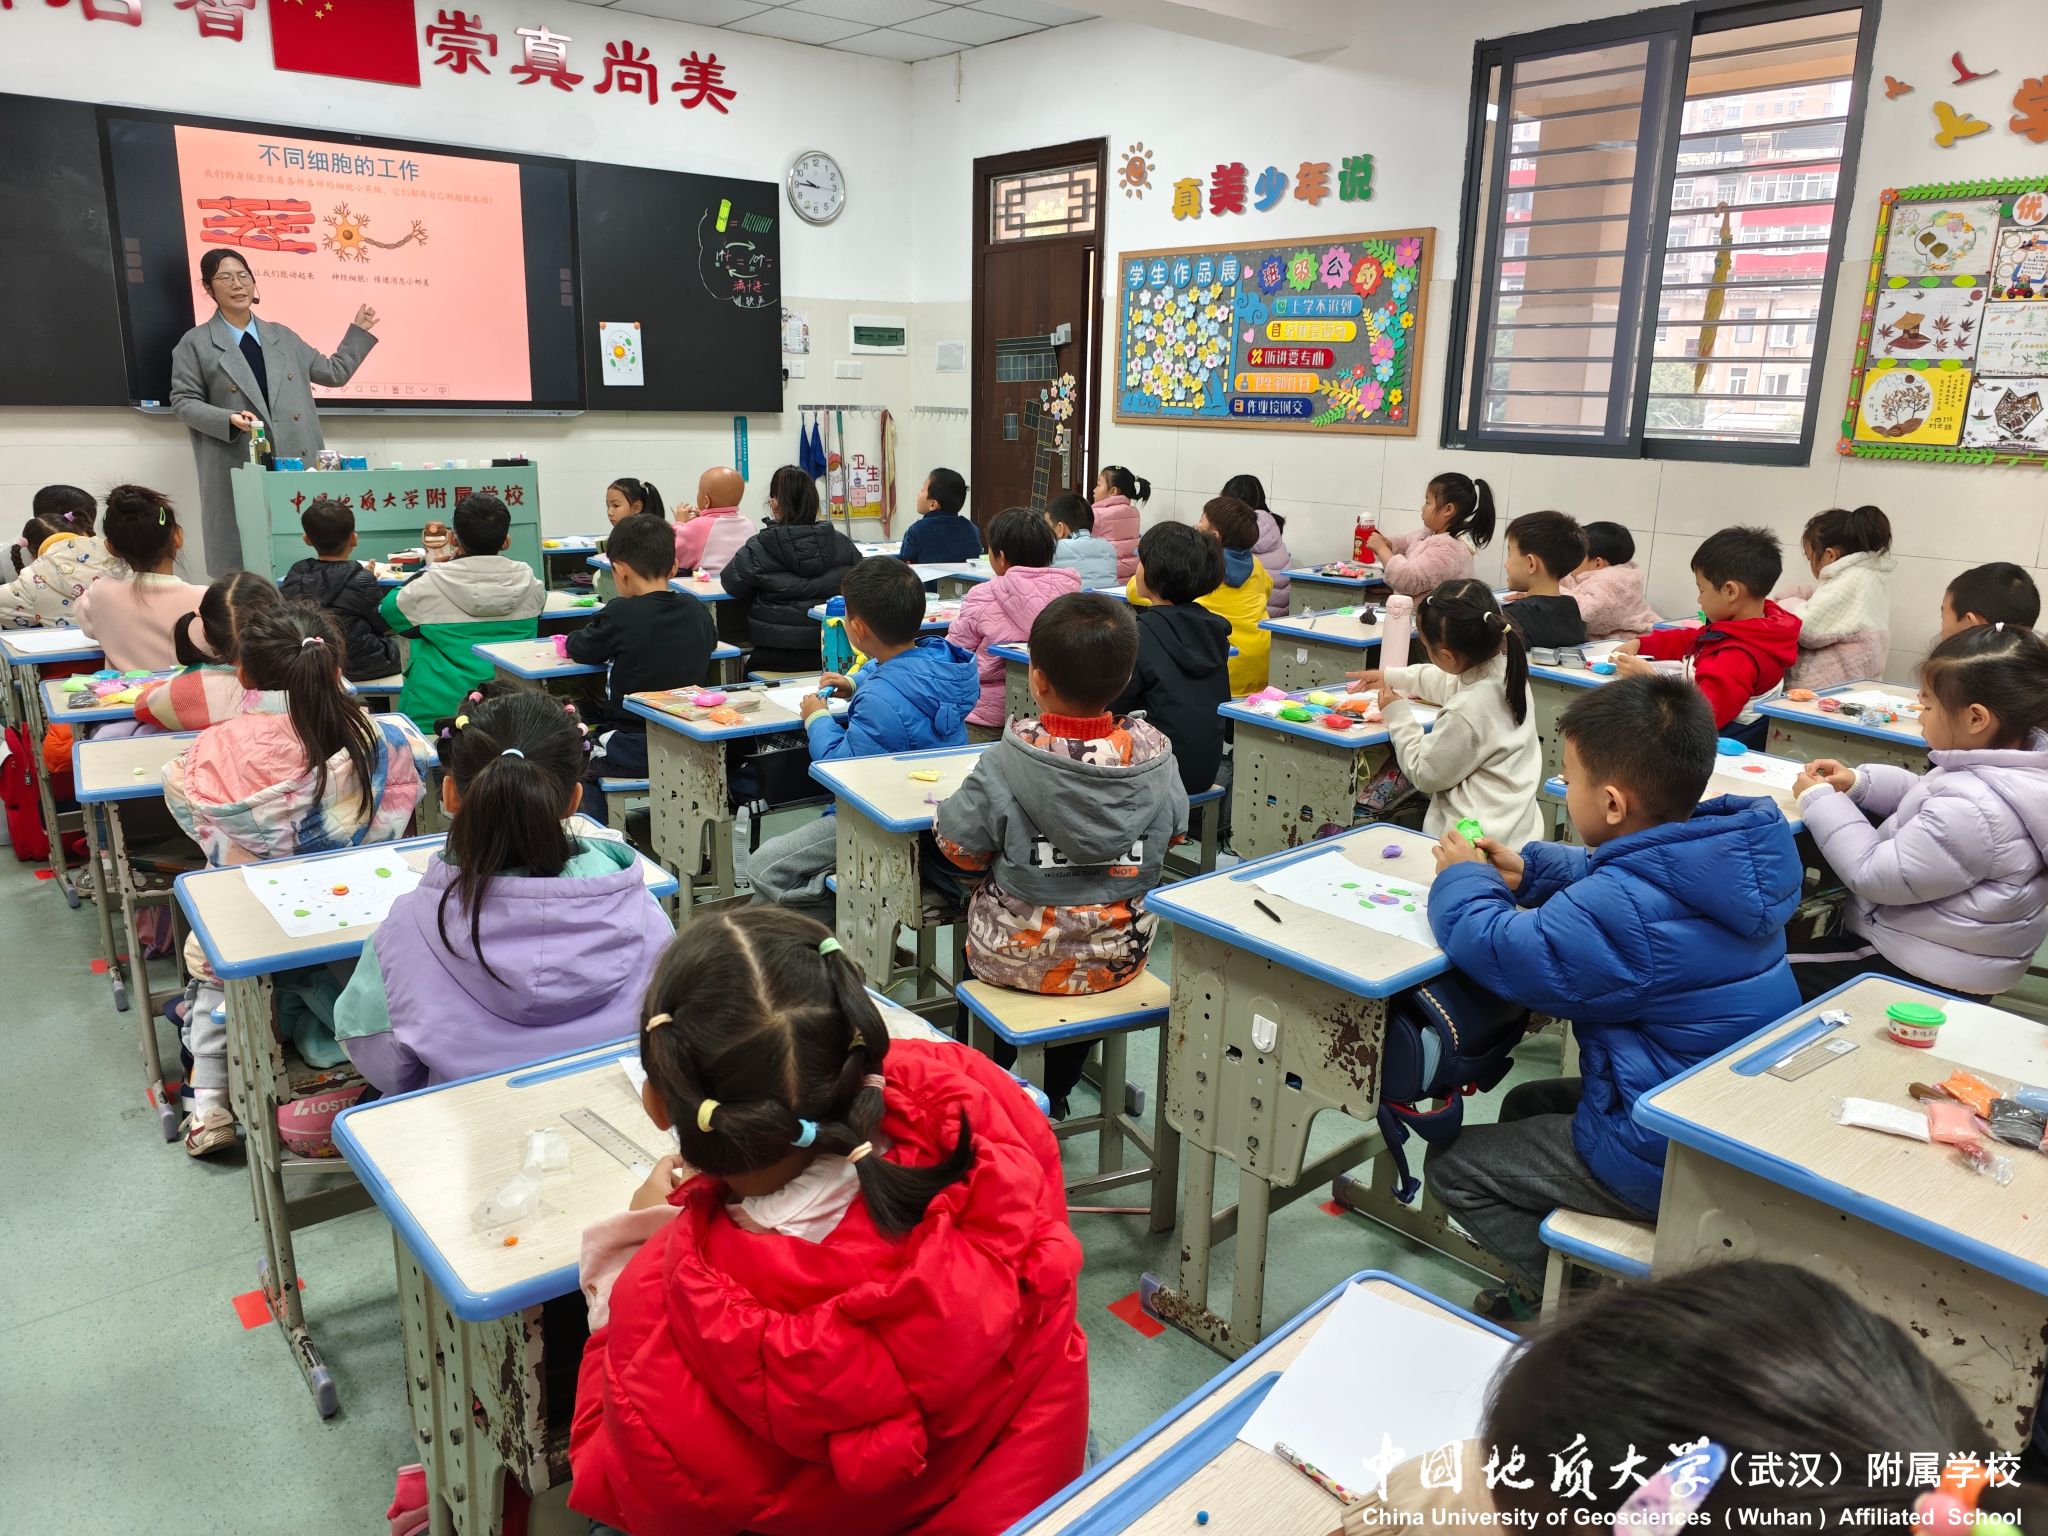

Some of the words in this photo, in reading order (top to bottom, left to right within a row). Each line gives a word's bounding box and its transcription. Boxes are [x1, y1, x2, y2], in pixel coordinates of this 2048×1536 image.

[426, 9, 737, 115] 崇真尚美
[258, 143, 420, 182] 不同细胞的工作
[1172, 153, 1373, 220] 真美少年说
[1128, 259, 1238, 290] 学生作品展
[1262, 255, 1376, 290] 班级公约
[1291, 299, 1353, 314] 上学不迟到
[1264, 350, 1325, 366] 听讲要专心
[1247, 400, 1303, 415] 作业按时交
